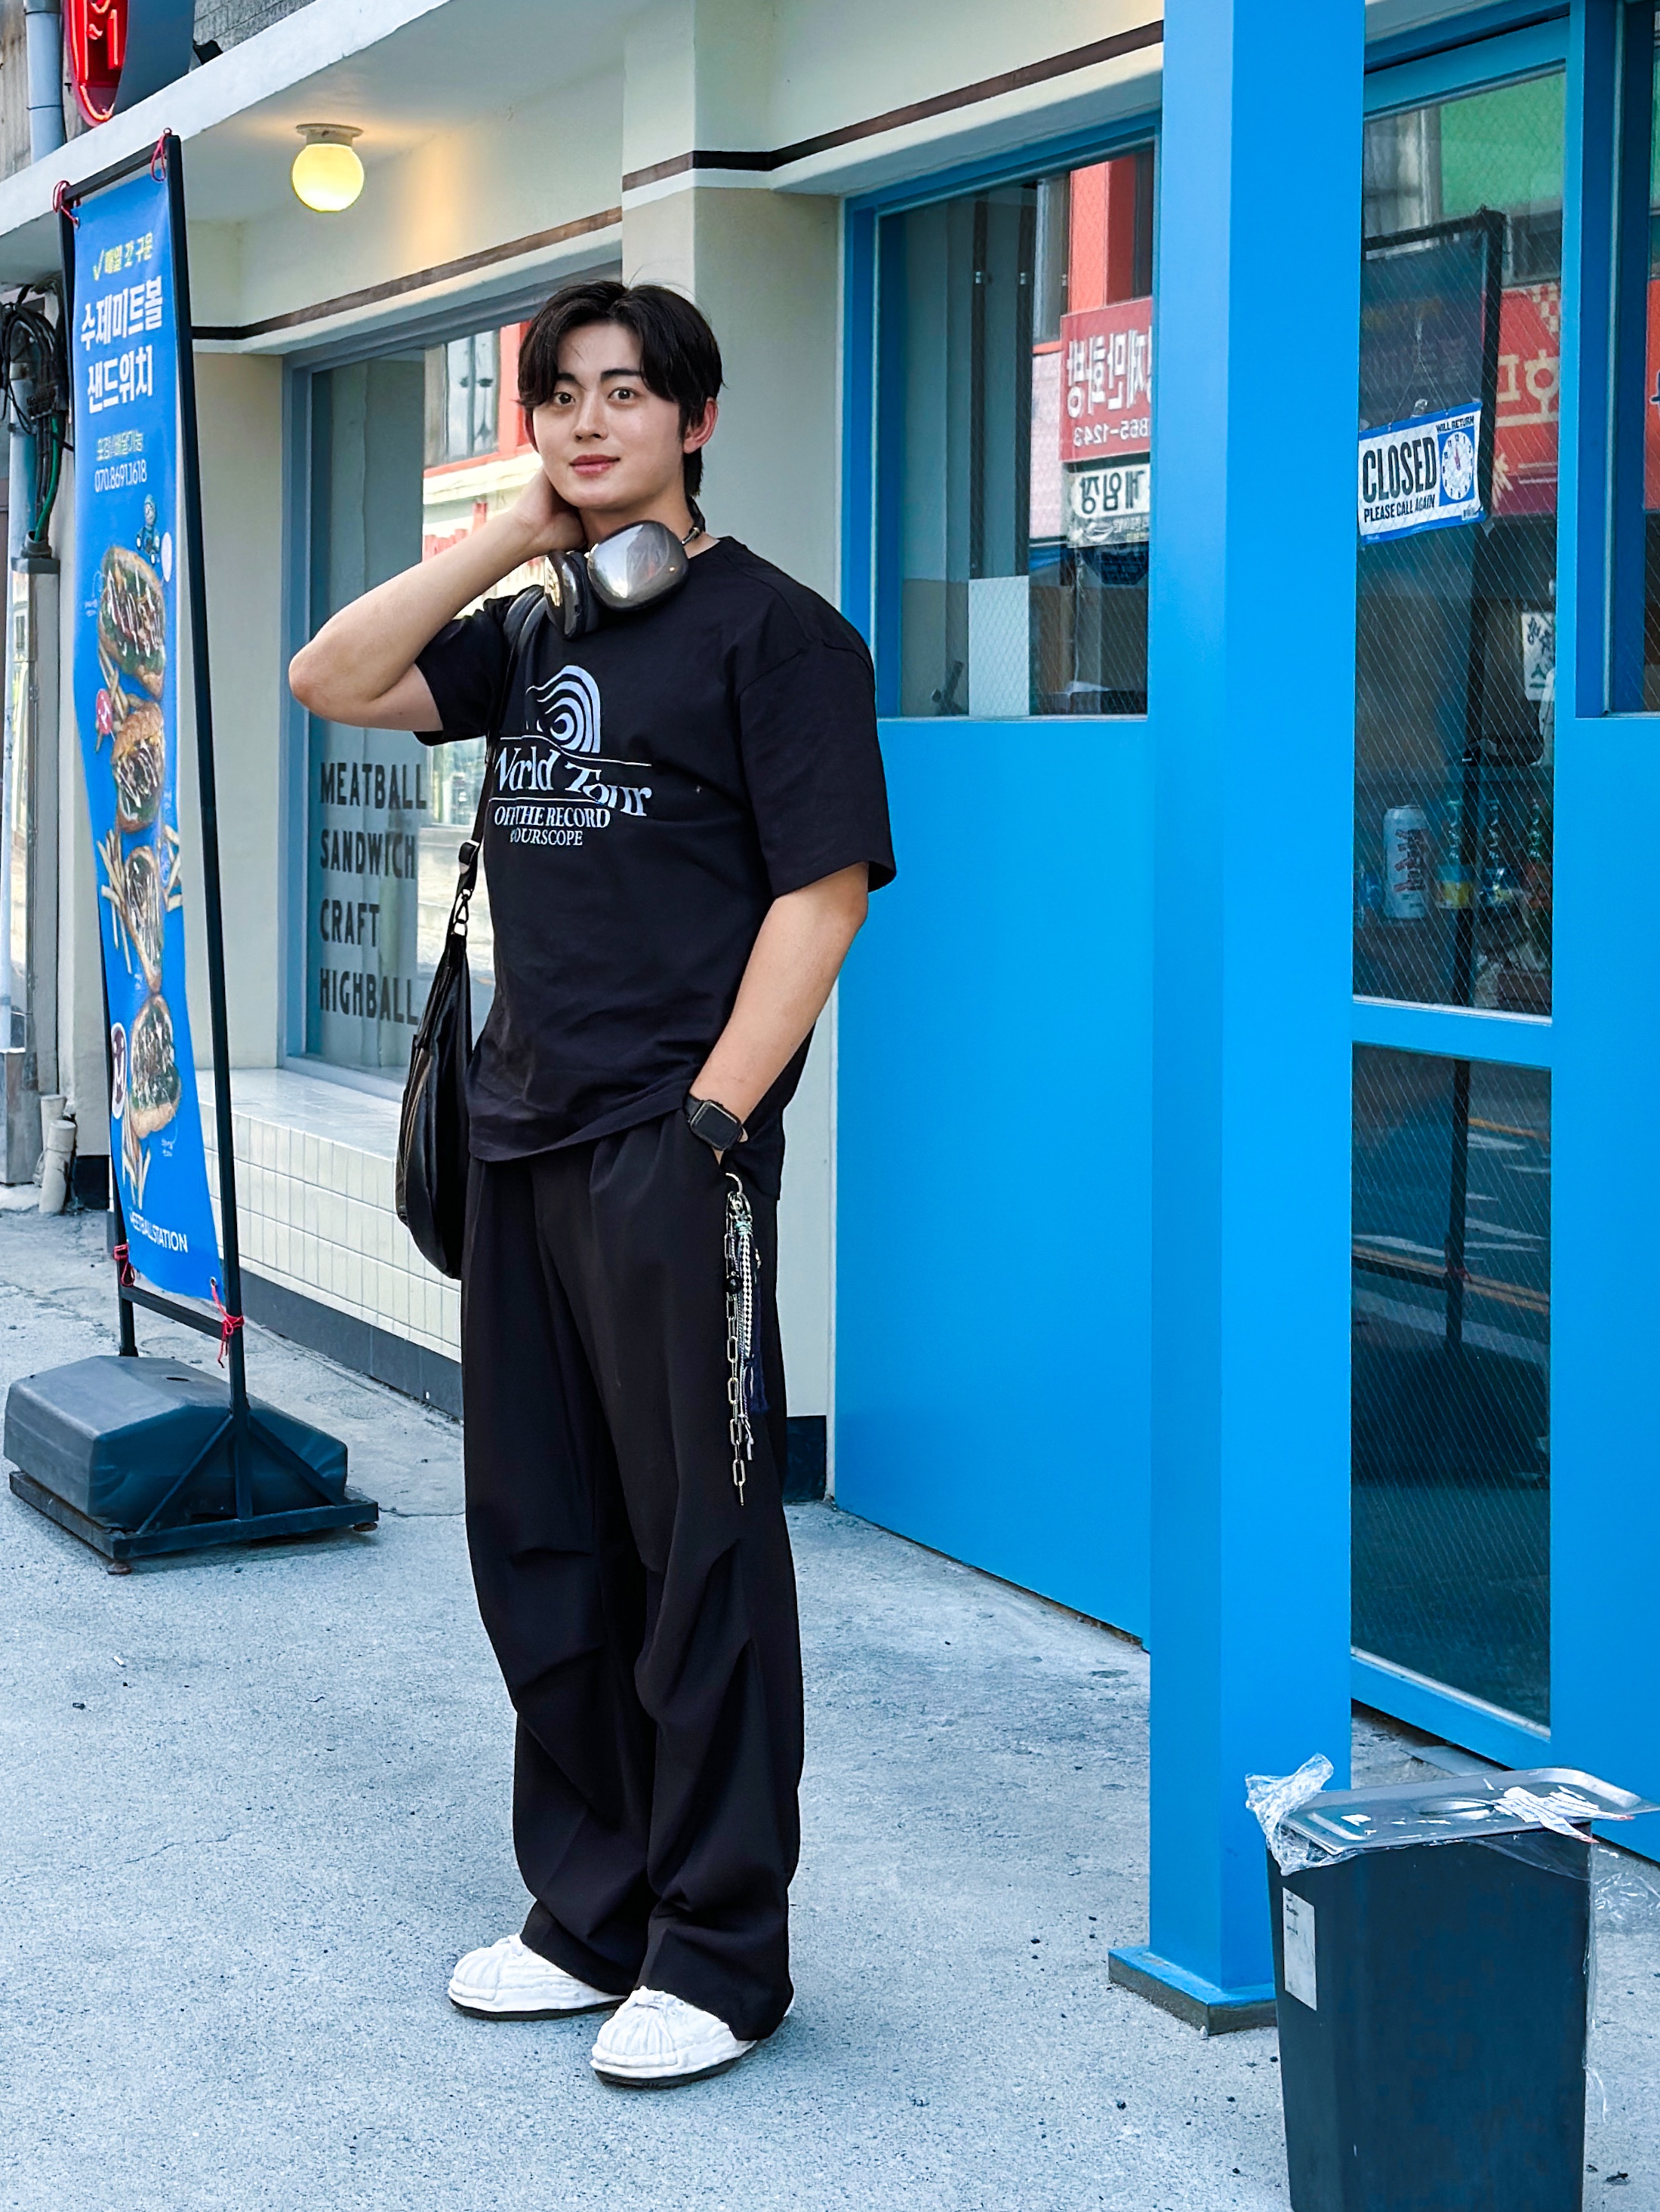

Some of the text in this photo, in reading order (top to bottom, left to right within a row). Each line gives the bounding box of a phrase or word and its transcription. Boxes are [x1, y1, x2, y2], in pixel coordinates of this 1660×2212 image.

[136, 232, 153, 263] 구운
[81, 275, 163, 351] 수제미트볼
[88, 345, 153, 414] 샌드위치
[1436, 423, 1450, 433] WILL
[1363, 436, 1437, 503] CLOSED
[1364, 494, 1436, 523] PLEASE CALL AGAIN
[320, 762, 427, 810] MEATBALL
[565, 761, 652, 817] Tour
[545, 807, 611, 828] RECORD
[320, 829, 415, 879] SANDWICH
[320, 898, 380, 948] CRAFT
[320, 968, 419, 1026] HIGHBALL
